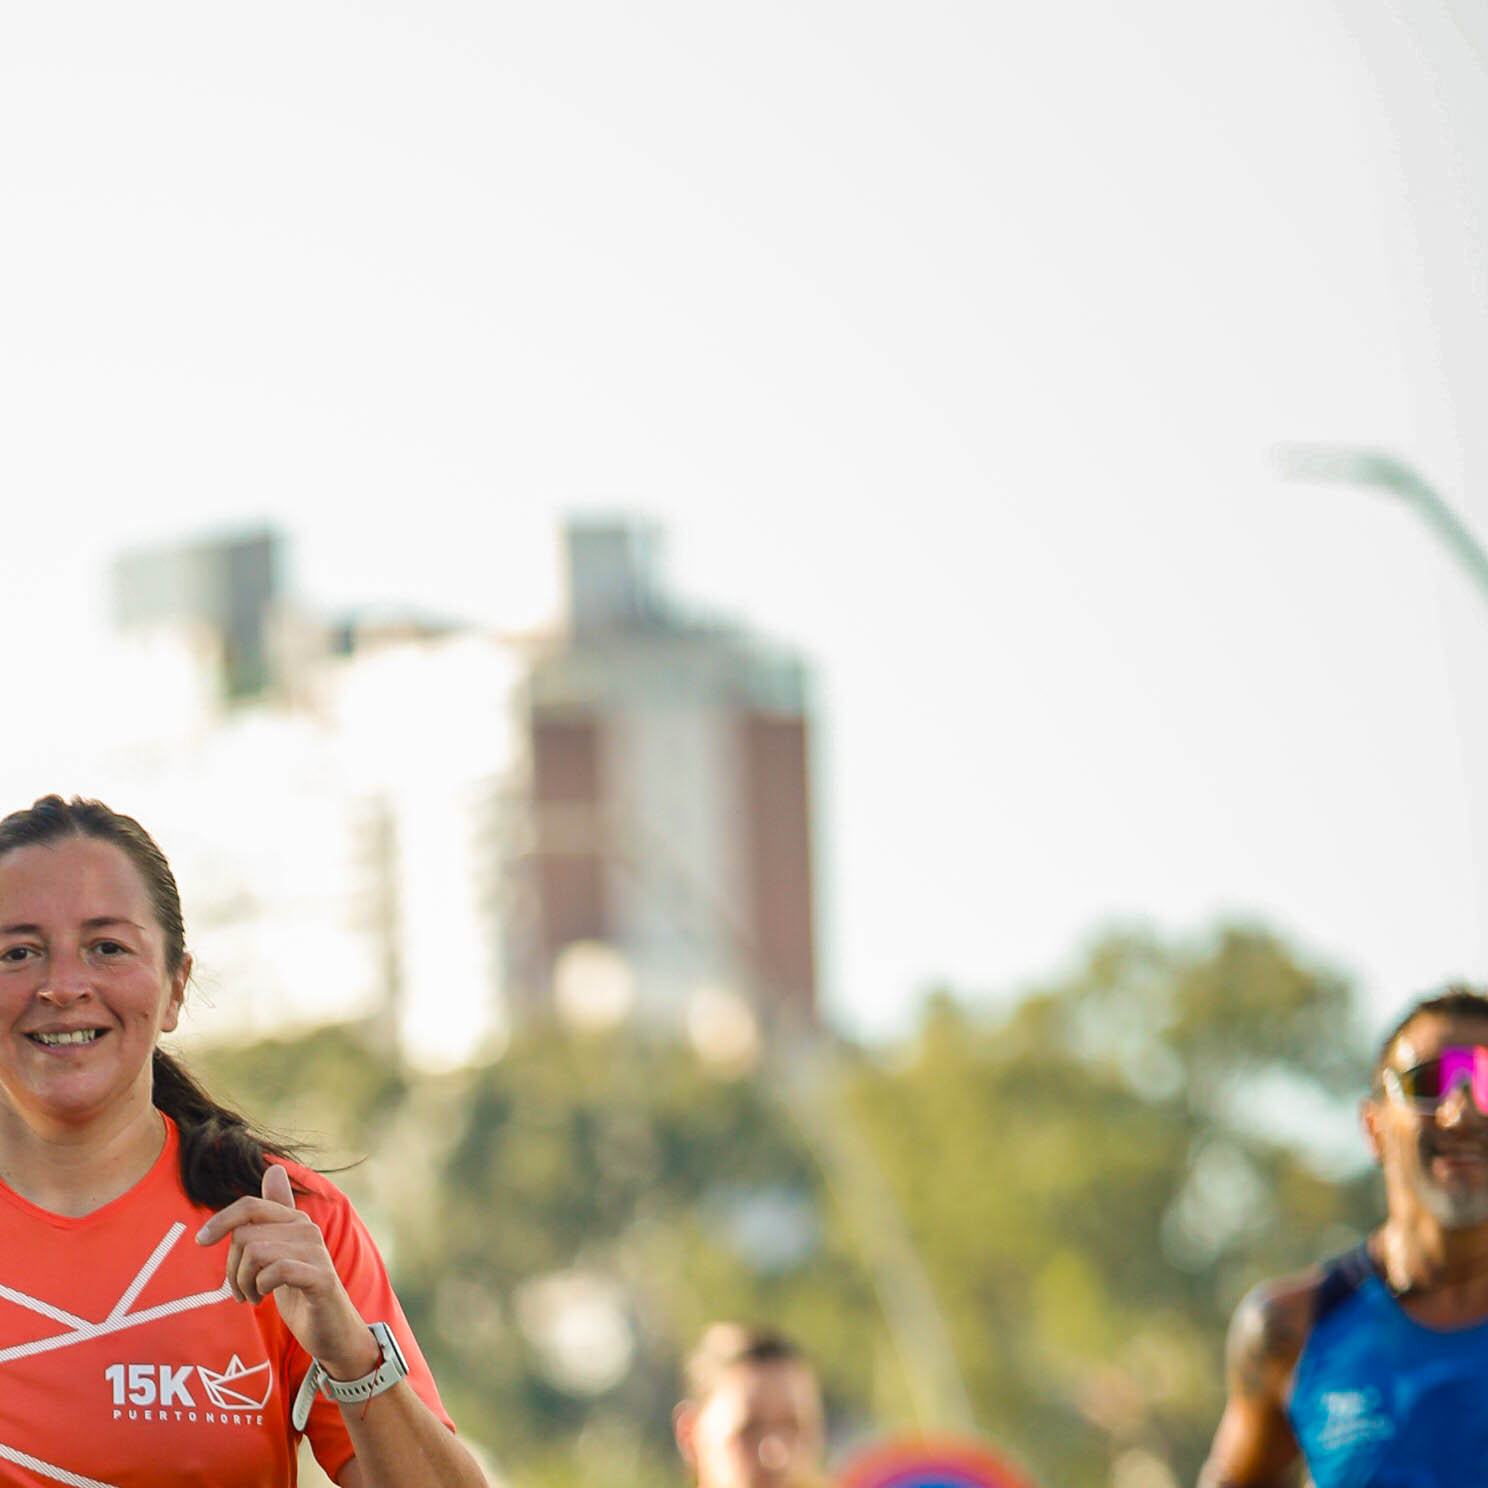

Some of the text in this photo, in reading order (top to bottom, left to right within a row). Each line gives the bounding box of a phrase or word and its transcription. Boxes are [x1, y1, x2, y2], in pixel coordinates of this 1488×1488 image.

[105, 1364, 196, 1407] 15K
[113, 1409, 263, 1425] PUERTO NORTE
